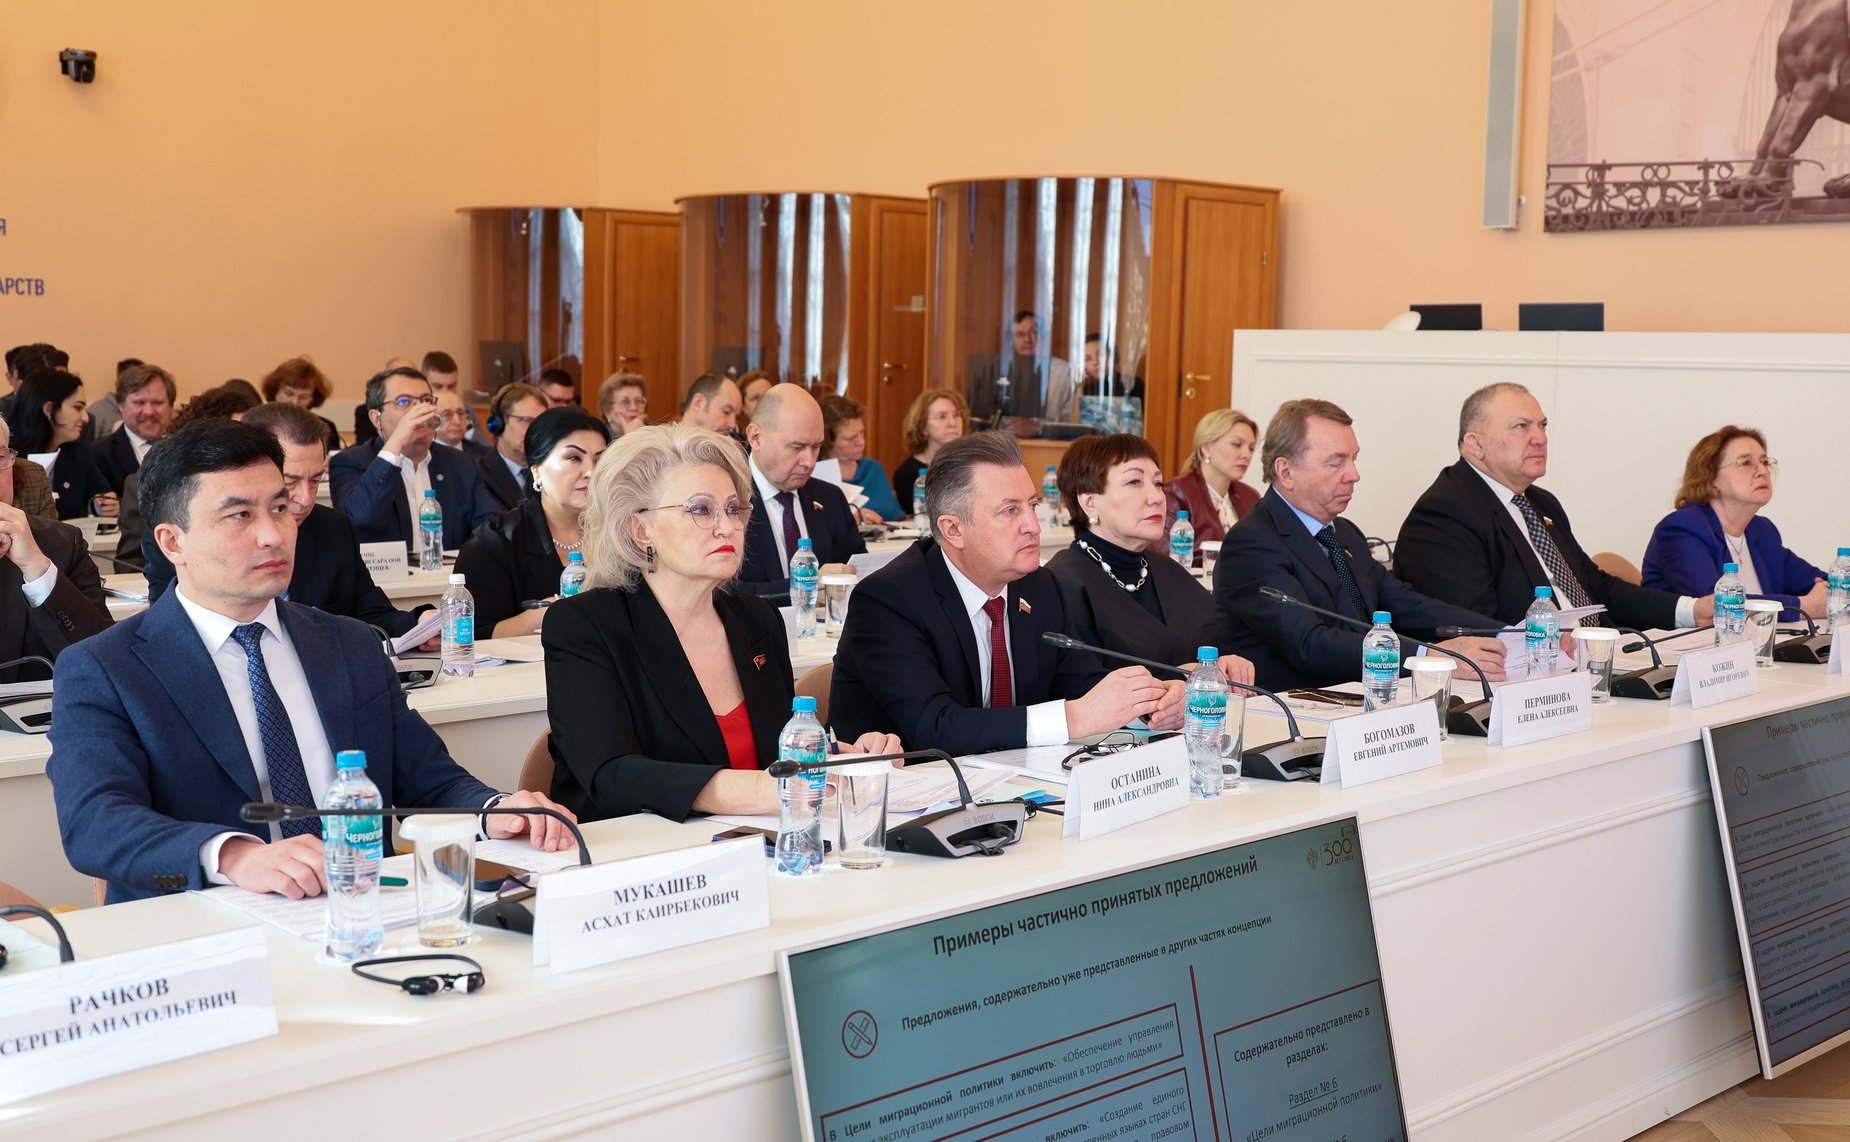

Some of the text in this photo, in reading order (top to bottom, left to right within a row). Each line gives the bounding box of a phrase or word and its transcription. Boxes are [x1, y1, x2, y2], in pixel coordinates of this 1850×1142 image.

[1712, 660, 1735, 673] КОЖИН
[1517, 705, 1579, 723] ЕЛЕНА АЛЕКСЕЕВНА
[1524, 692, 1571, 709] ПЕРМИНОВА
[1353, 736, 1429, 761] ЕВГЕНИЙ АРТЕМОВИЧ
[1363, 723, 1416, 744] БОГОМАЗОВ
[1093, 777, 1180, 812] НИНА АЛЕКСАНДРОВНА
[1111, 765, 1161, 790] ОСТАНИНА
[973, 812, 995, 824] BOSCH
[613, 873, 708, 906] МУКАШЕВ
[933, 855, 1258, 957] Примеры частично принятых предложений
[581, 890, 740, 934] АСХАТ КАИРБЕКОВИЧ
[902, 914, 1272, 1030] Предложения, содержательно уже представленные в других частях концепции
[69, 977, 170, 1015] РАЧКОВ
[0, 990, 238, 1056] СЕРГЕЙ АНАТОЛЬЕВИЧ
[1234, 1007, 1370, 1062] Содержательно представлено в
[1285, 1042, 1329, 1068] разделах:
[829, 1020, 1174, 1142] В Цели миграционной политики включить: «Обеспечение управления
[878, 1041, 1163, 1142] эксплуатации мигрантов или их вовлечения в торговлю людьми»
[1288, 1077, 1338, 1107] Раздел № 6
[1045, 1087, 1185, 1142] включить: «Создание единого
[1119, 1118, 1148, 1136] языках
[1148, 1109, 1171, 1125] стран
[1172, 1101, 1187, 1115] СНГ
[1246, 1082, 1383, 1142] «Цели миграционной политики»
[1150, 1120, 1190, 1141] правовом
